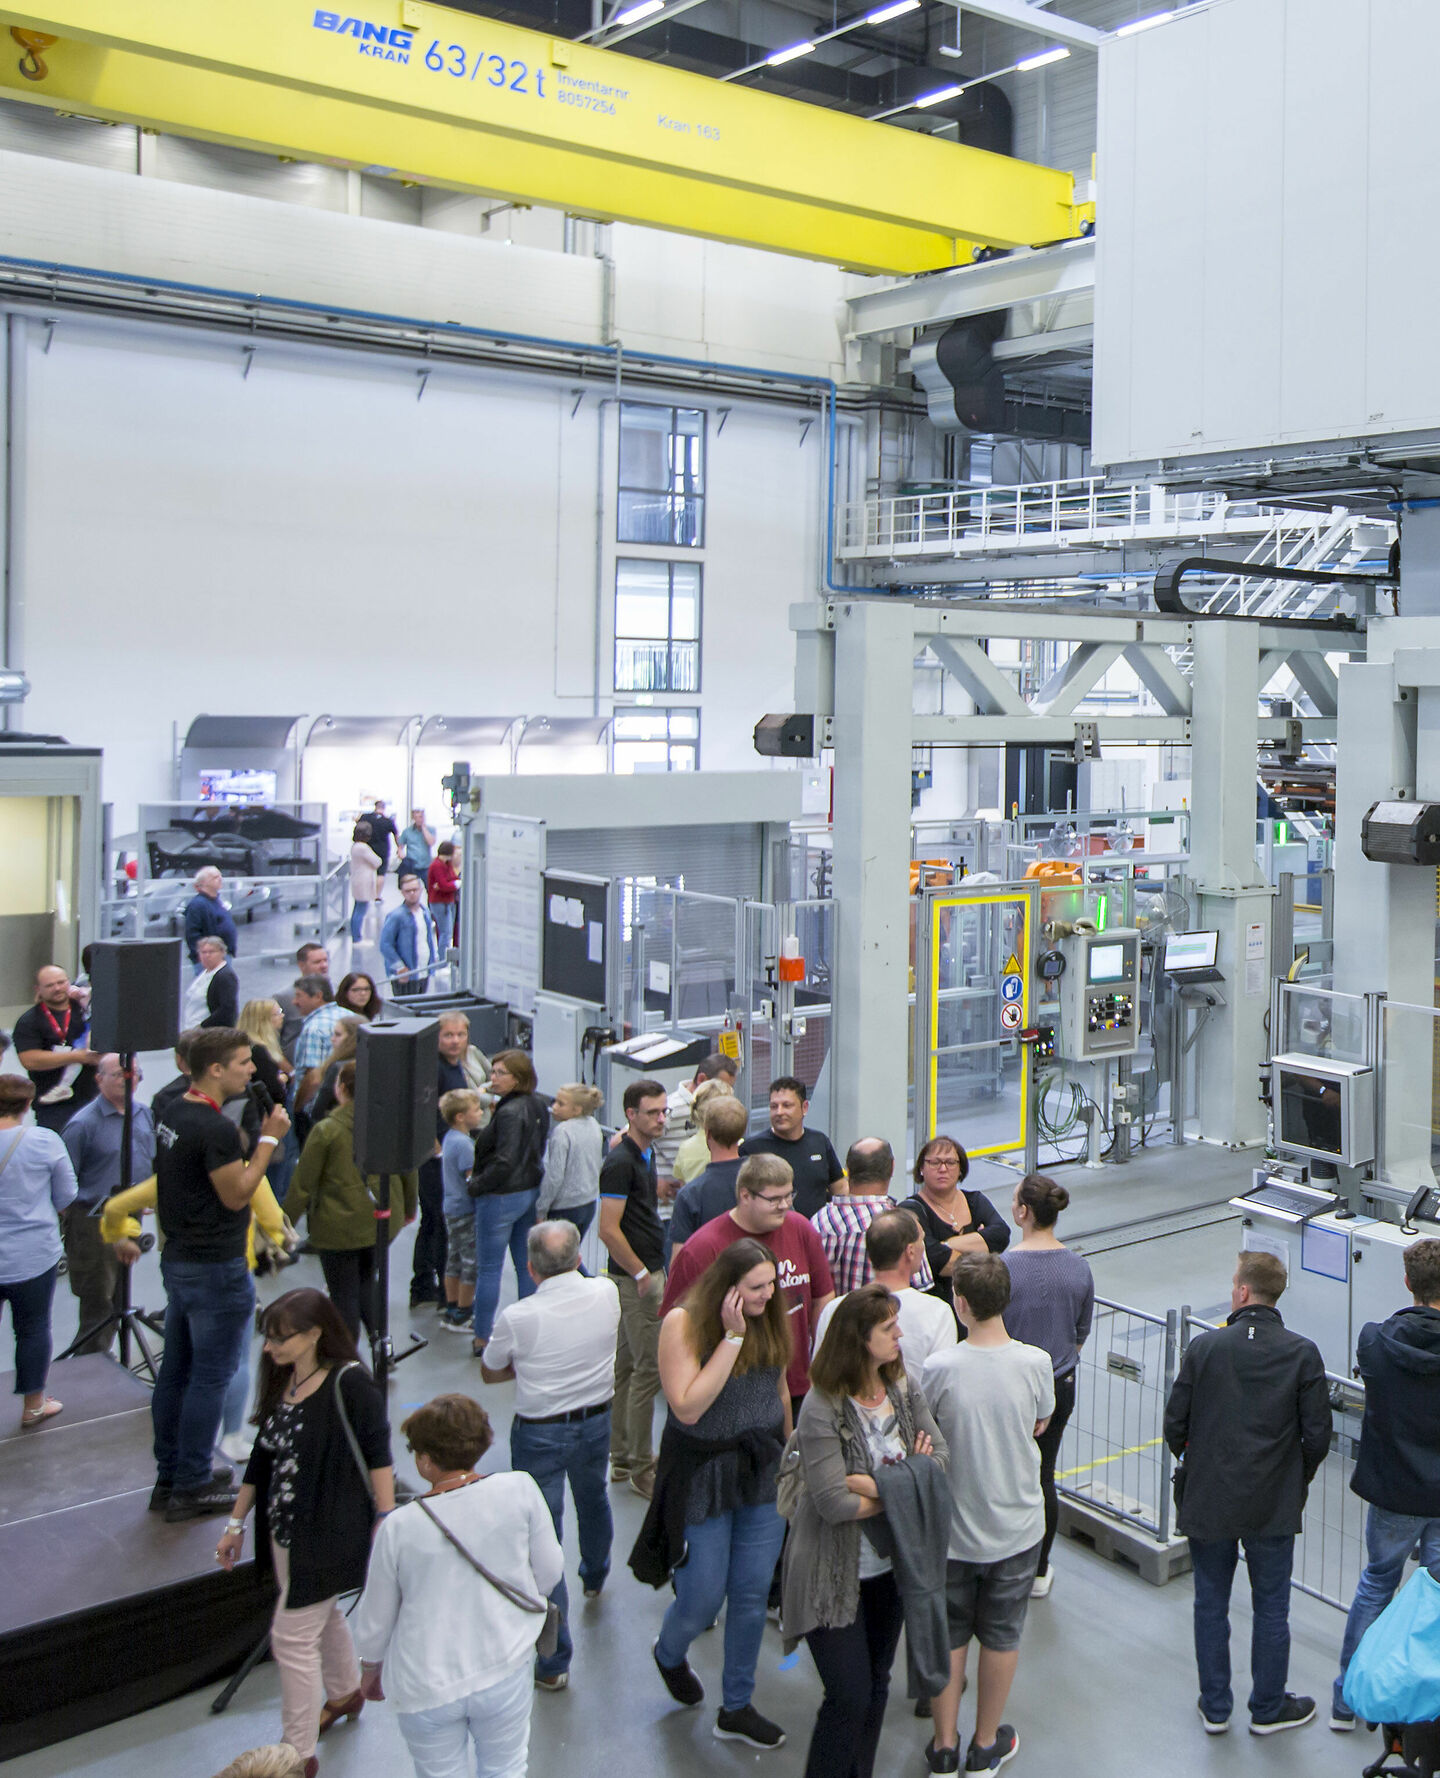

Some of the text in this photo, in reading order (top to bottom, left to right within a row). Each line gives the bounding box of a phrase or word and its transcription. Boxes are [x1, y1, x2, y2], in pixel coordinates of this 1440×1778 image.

[312, 9, 414, 50] BANG
[358, 42, 410, 65] KRAN
[656, 114, 691, 134] Kran
